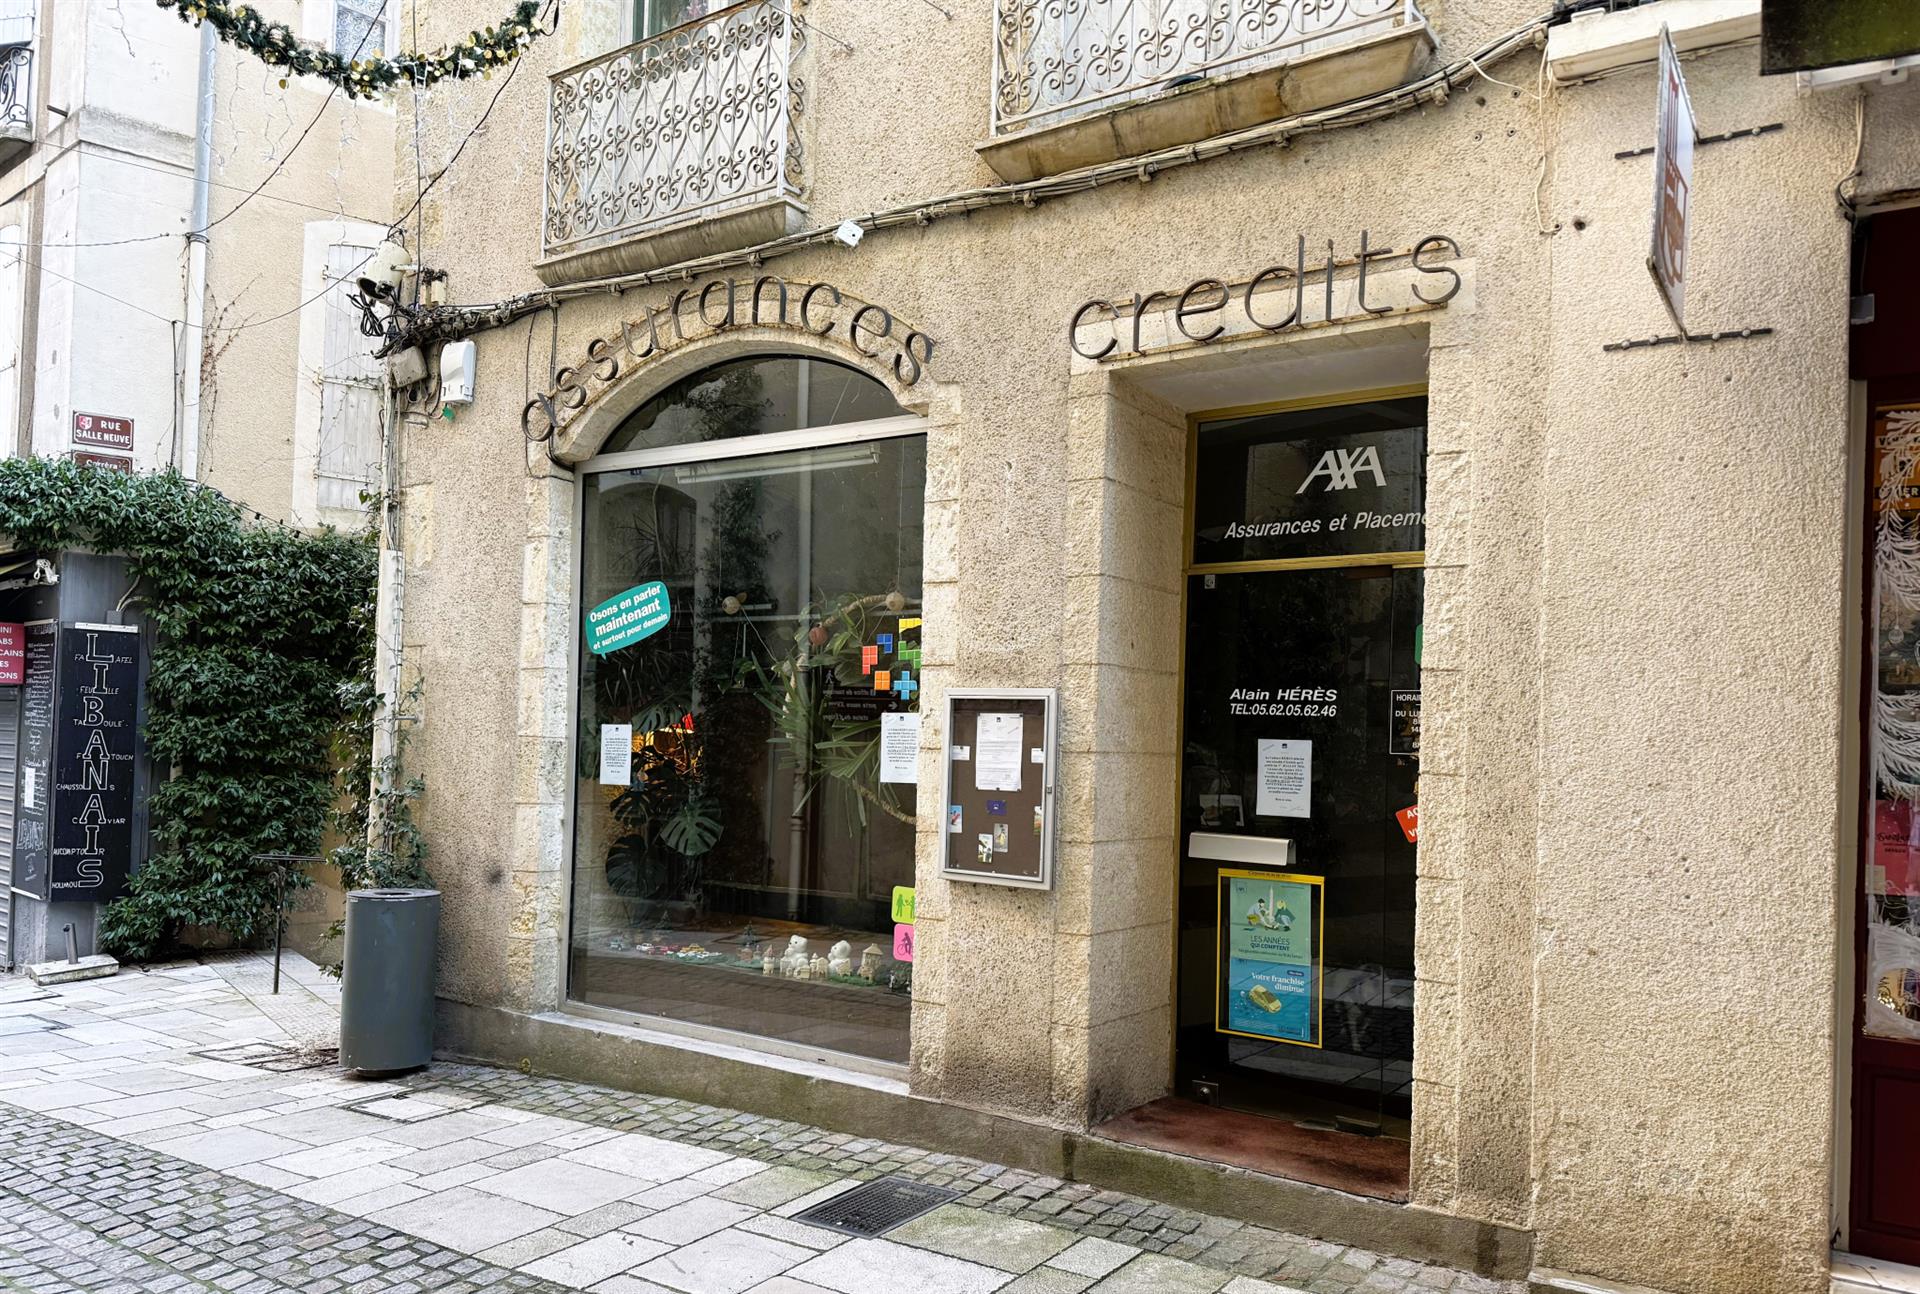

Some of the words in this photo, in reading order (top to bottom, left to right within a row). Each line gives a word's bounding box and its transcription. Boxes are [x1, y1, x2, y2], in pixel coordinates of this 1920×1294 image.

[1068, 229, 1462, 359] credits
[521, 275, 935, 442] assurances
[100, 420, 121, 431] RUE
[76, 429, 102, 440] SALLE
[103, 432, 130, 444] NEUVE
[1295, 446, 1387, 495] AXA
[1224, 518, 1321, 539] Assurances
[1329, 513, 1348, 532] et
[590, 604, 618, 623] Osons
[620, 598, 632, 610] en
[633, 585, 661, 606] parler
[595, 597, 661, 637] maintenant
[593, 641, 601, 650] et
[602, 630, 626, 647] surtout
[626, 625, 642, 638] pour
[643, 613, 668, 629] demain
[1229, 688, 1270, 701] Alain
[1277, 686, 1338, 702] HÉRÈS
[1230, 703, 1338, 717] TEL:05.62.05.62.46
[76, 633, 114, 887] LIBANAIS
[1250, 935, 1262, 943] LES
[1263, 936, 1290, 946] ANNÉES
[1261, 943, 1290, 951] COMPTENT
[1252, 971, 1271, 981] Votre
[1271, 974, 1304, 986] franchise
[1274, 983, 1304, 993] diminue
